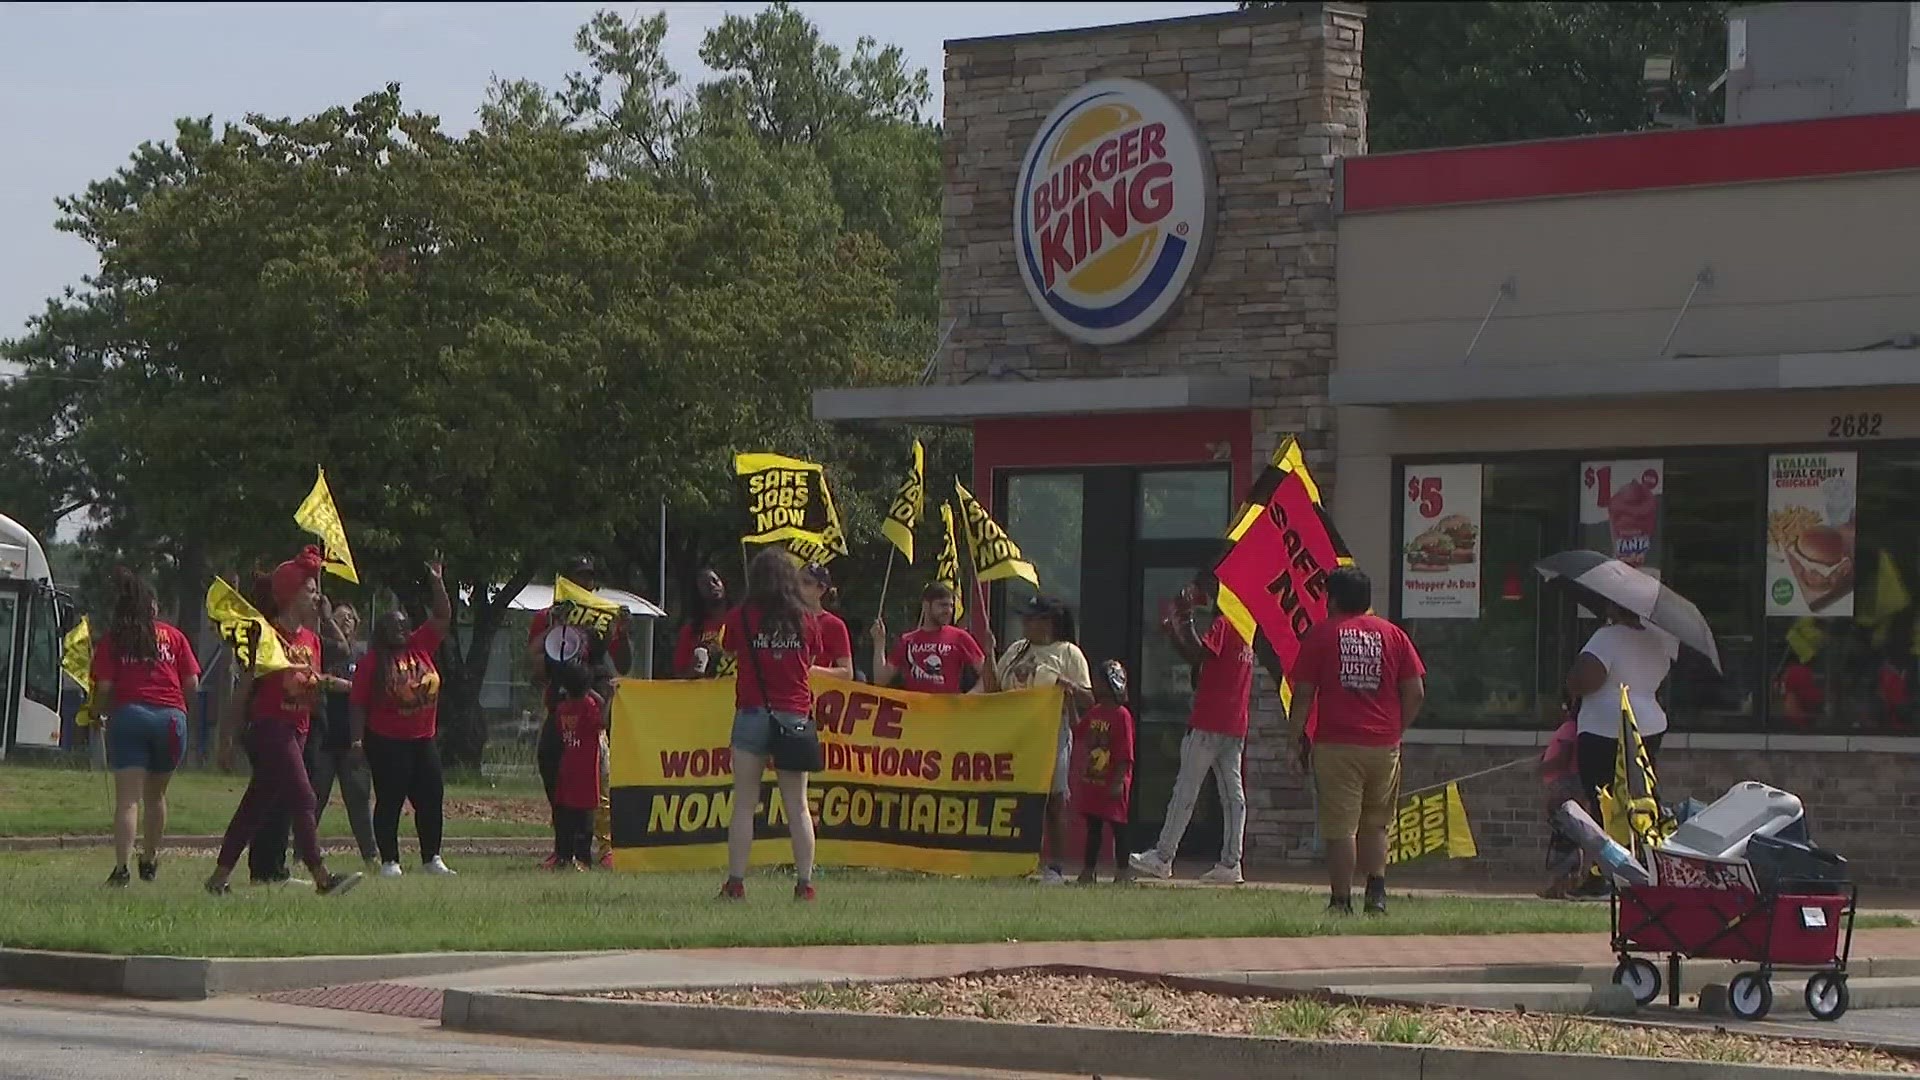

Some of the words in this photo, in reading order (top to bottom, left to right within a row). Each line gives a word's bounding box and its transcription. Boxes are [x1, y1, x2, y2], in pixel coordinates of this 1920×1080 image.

[1033, 121, 1167, 233] BURGER
[1039, 161, 1174, 292] KING
[1828, 412, 1882, 438] 2682
[1775, 457, 1827, 469] ITALIAN
[749, 470, 809, 494] SAFE
[1584, 465, 1611, 508] $1
[1775, 478, 1820, 488] CHICKEN
[749, 486, 809, 513] JOBS
[1408, 476, 1443, 518] $5
[757, 507, 805, 532] NOW
[1405, 578, 1444, 592] Whopper
[1460, 579, 1476, 589] Duo
[752, 639, 769, 649] THE
[1340, 643, 1382, 657] WORKER
[1340, 662, 1382, 676] JUSTICE
[815, 690, 909, 740] AFE
[660, 748, 732, 779] WOR
[951, 752, 1015, 782] ARE
